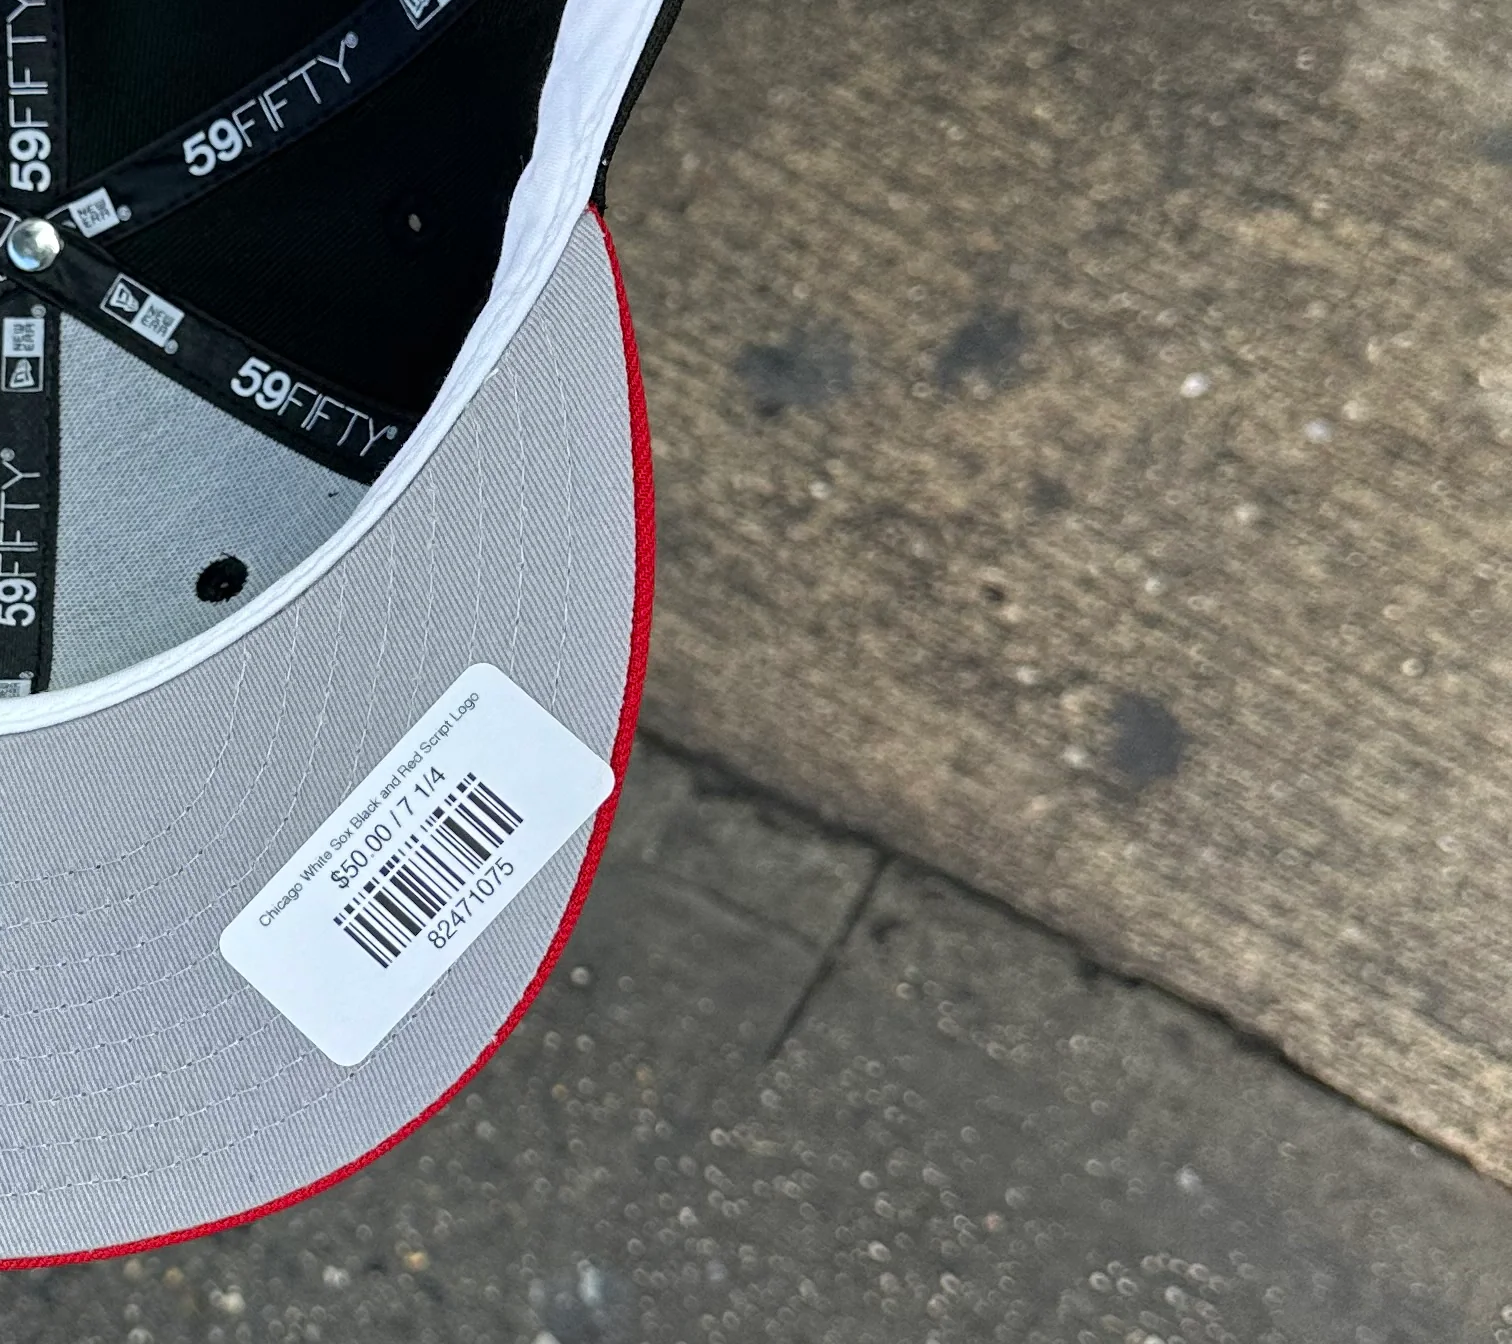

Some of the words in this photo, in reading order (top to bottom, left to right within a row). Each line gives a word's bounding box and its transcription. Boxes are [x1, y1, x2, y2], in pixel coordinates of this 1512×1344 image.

[183, 40, 352, 177] 59FIFTY
[229, 356, 389, 456] 59FIFTY
[259, 882, 303, 927] Chicago
[299, 851, 333, 881] White
[329, 828, 355, 851] Sox
[349, 797, 381, 830] Black
[379, 775, 402, 800] and
[396, 751, 424, 778] Red
[419, 719, 454, 754] Script
[448, 692, 480, 722] Logo
[330, 824, 393, 890] $50.00
[389, 809, 402, 828] /
[396, 795, 414, 816] 7
[414, 766, 446, 798] 1/4
[427, 856, 514, 949] 82471075
